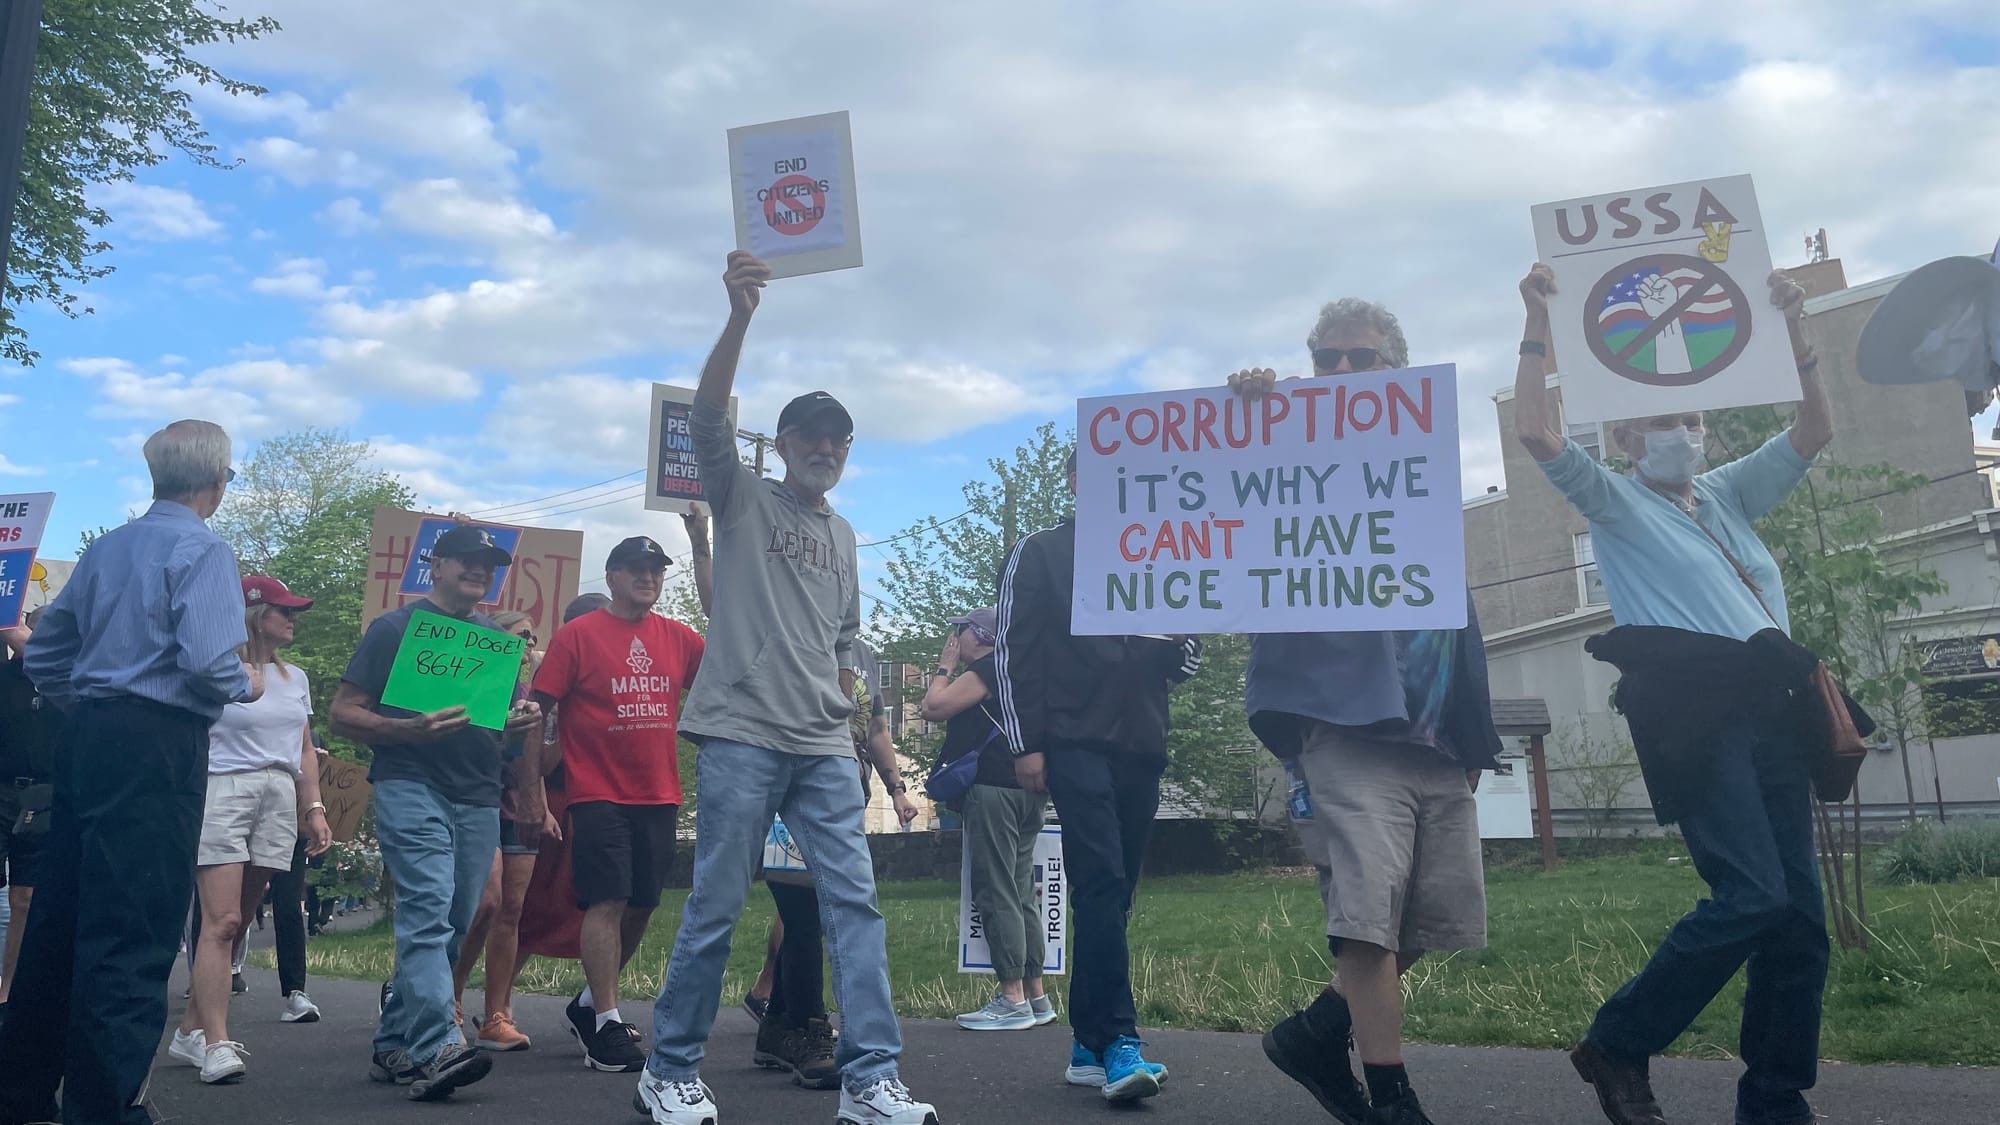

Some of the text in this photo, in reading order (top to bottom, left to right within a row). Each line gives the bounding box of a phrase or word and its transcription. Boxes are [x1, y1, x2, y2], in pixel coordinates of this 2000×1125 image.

[774, 157, 807, 174] END
[757, 179, 830, 202] CITIZENS
[766, 206, 825, 227] UNITED
[1555, 186, 1739, 245] USSA
[1089, 377, 1433, 456] CORRUPTION
[680, 451, 698, 465] WIL
[1230, 464, 1341, 508] WHY
[1363, 456, 1429, 499] WE
[1119, 510, 1396, 562] CAN'T HAVE
[414, 621, 522, 655] END DOGE!
[416, 650, 485, 679] 8647
[611, 676, 670, 694] MARCH
[617, 703, 668, 718] SCIENCE
[1047, 857, 1062, 943] TROUBLE!
